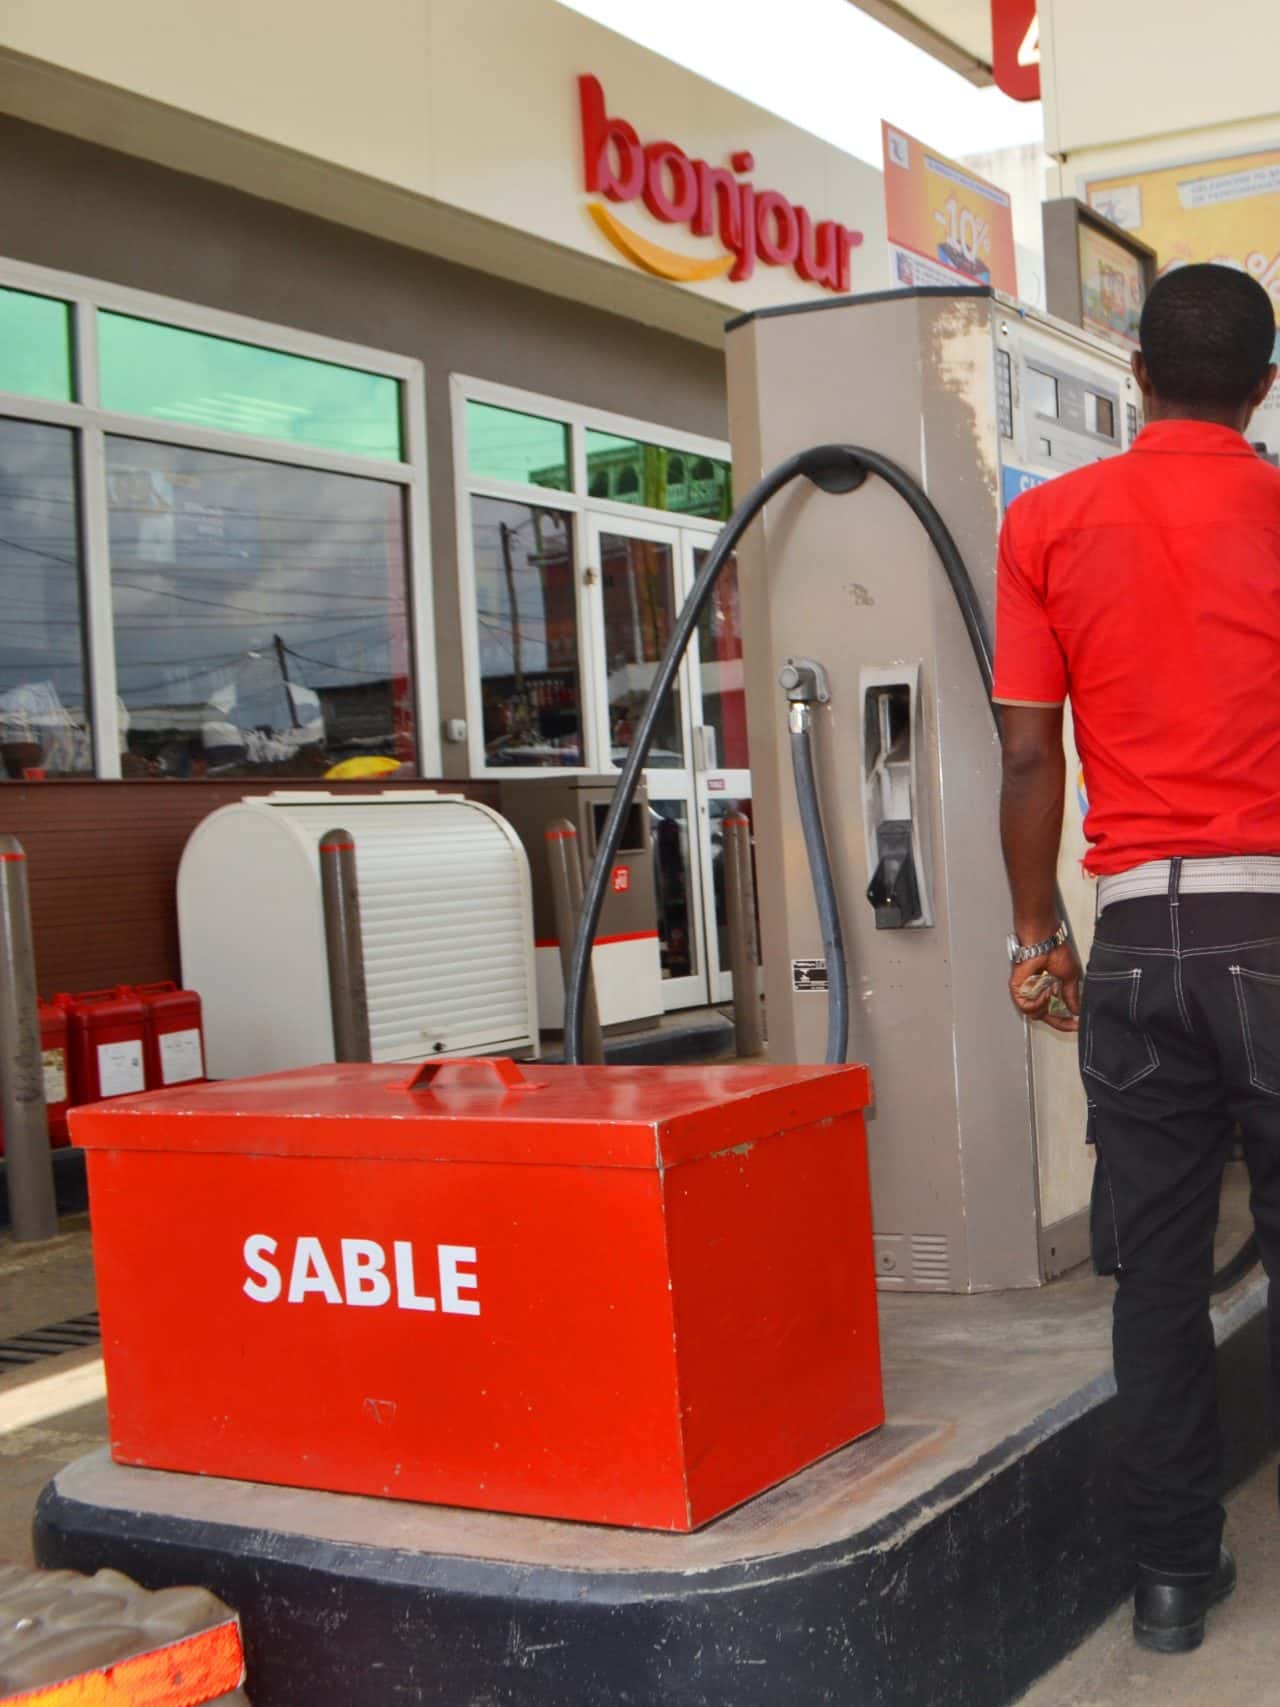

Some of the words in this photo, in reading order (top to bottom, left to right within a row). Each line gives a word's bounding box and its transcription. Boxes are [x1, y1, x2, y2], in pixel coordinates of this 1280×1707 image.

[578, 73, 864, 292] bonjour
[933, 198, 991, 264] -10%
[243, 1233, 481, 1316] SABLE
